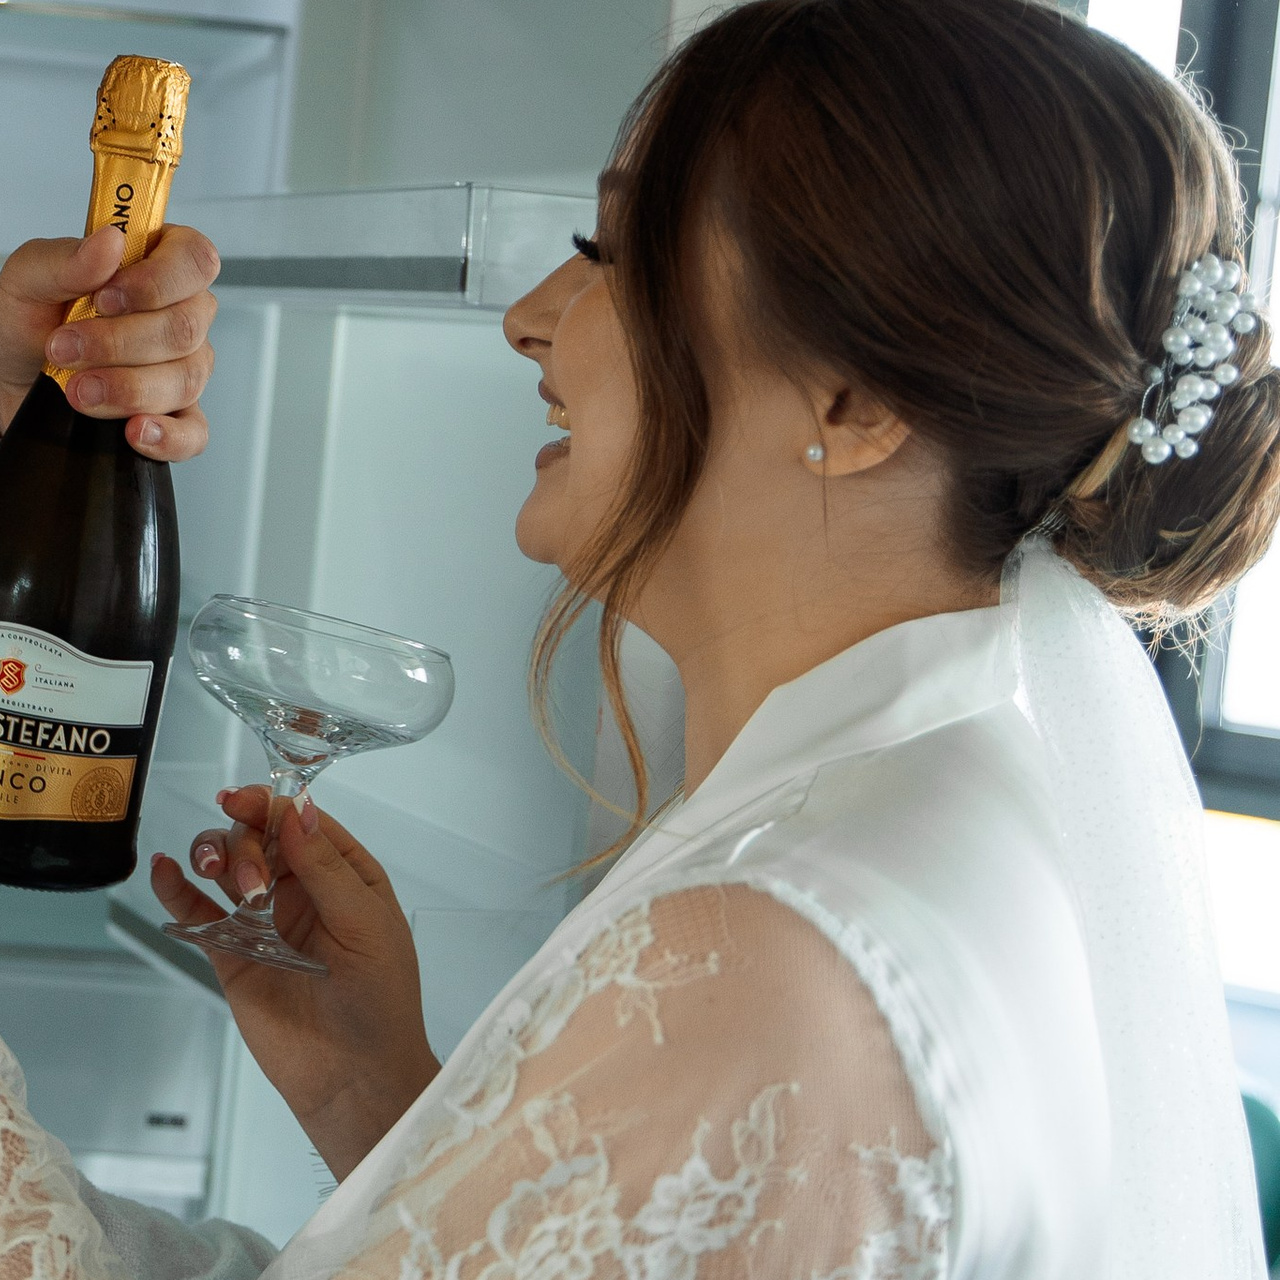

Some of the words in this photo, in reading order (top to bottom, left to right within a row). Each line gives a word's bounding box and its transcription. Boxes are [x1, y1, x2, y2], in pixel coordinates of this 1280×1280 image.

[8, 633, 62, 658] CONTROLLATA
[34, 677, 75, 688] ITALIANA
[1, 699, 54, 713] REGISTRATO
